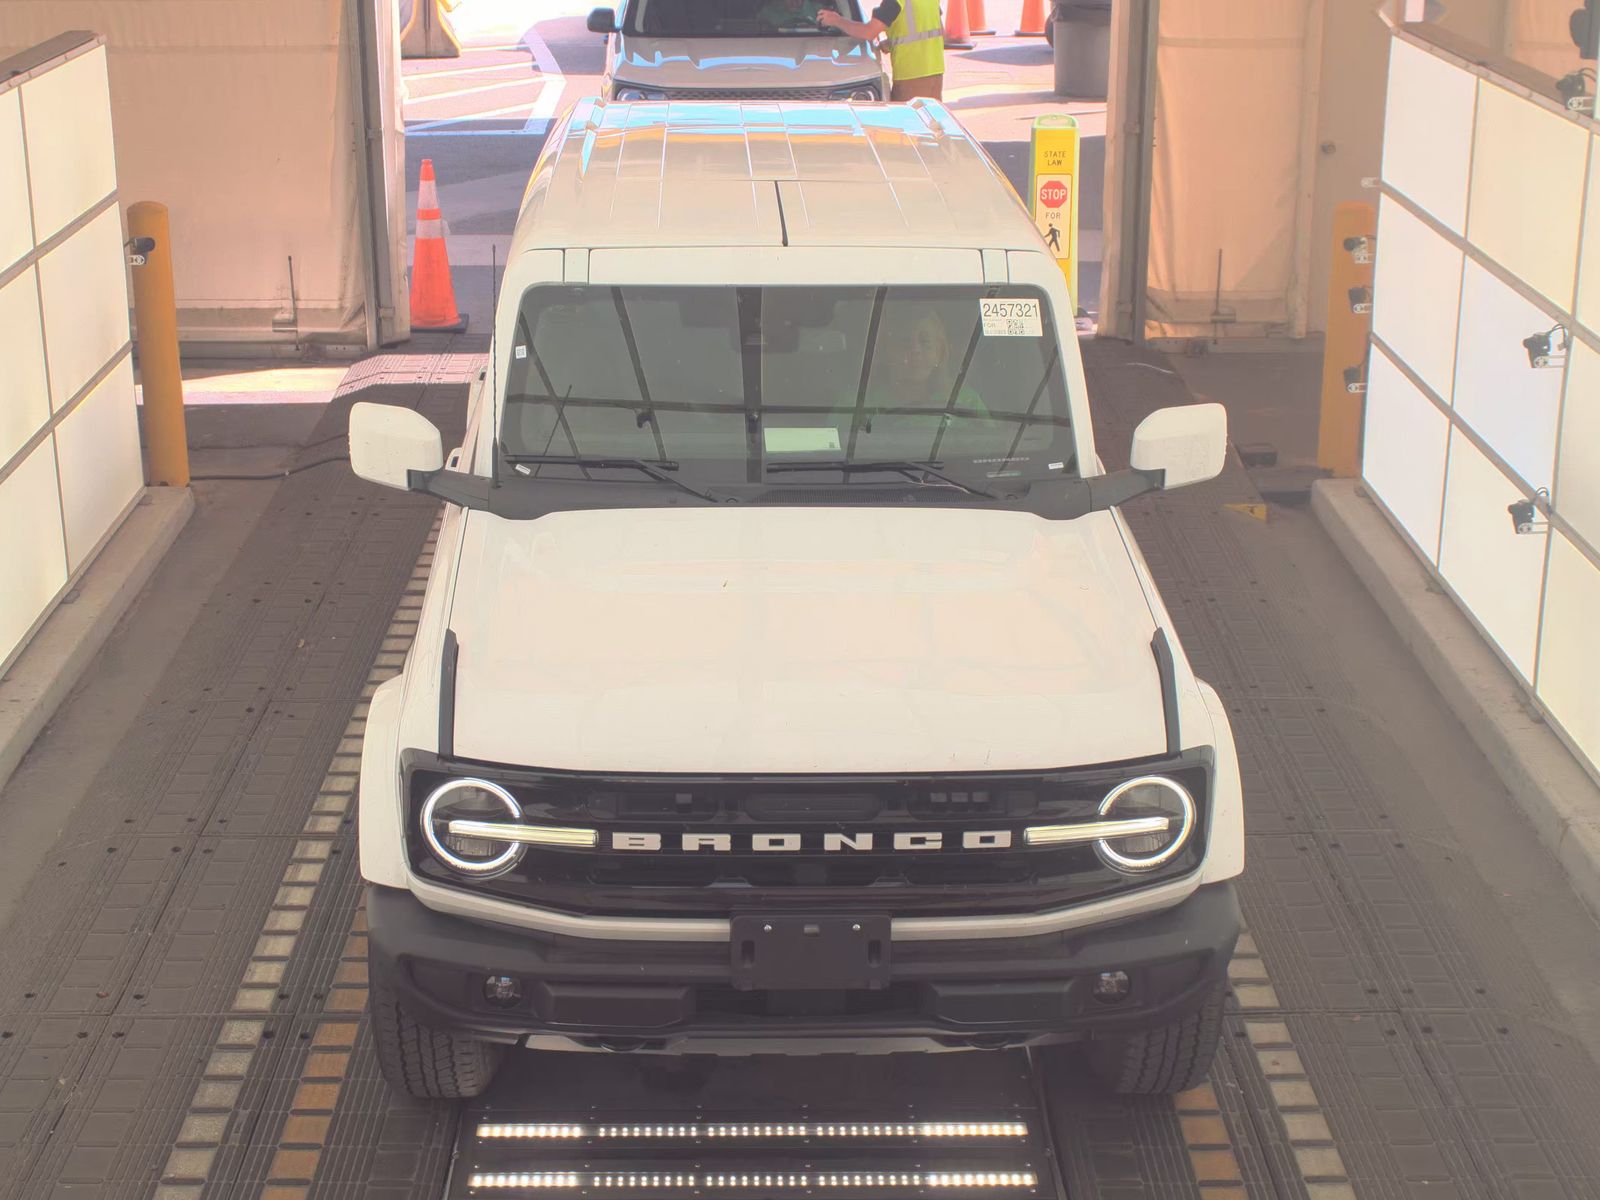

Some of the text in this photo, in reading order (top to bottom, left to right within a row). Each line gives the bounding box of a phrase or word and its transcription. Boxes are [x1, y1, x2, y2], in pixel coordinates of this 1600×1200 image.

[1044, 150, 1067, 158] STATE
[1041, 188, 1067, 200] STOP
[1045, 211, 1061, 220] FOR
[983, 303, 1038, 318] 2457321
[612, 830, 1012, 852] BRONCO
